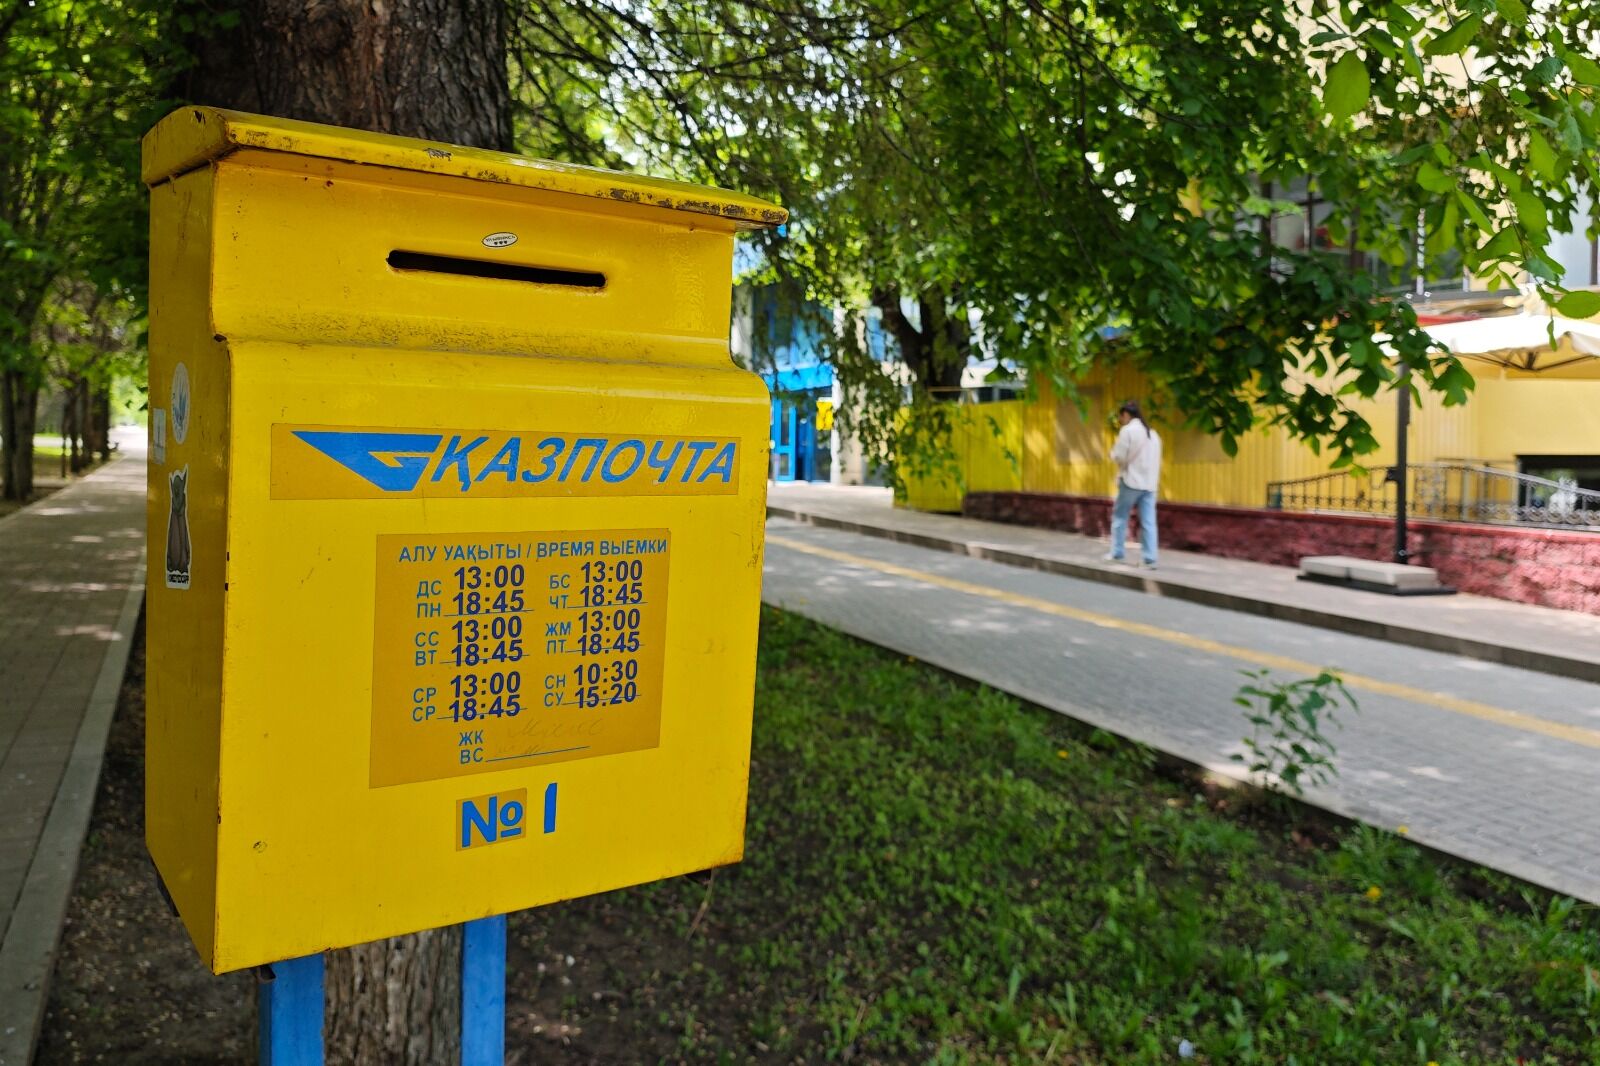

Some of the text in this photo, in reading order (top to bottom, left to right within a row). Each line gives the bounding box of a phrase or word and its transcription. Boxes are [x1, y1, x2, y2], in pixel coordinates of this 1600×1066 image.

[431, 435, 738, 492] ҚАЗПОЧТА
[399, 545, 437, 562] АЛУ
[444, 543, 521, 563] УАҚЫТЫ
[537, 541, 594, 558] ВРЕМЯ
[600, 539, 667, 555] ВЫЕМКИ
[416, 564, 525, 599] ДС 13:00
[549, 560, 643, 589] БС 13:00
[416, 590, 524, 618] ПН 18:45
[549, 582, 643, 609] ЧТ 18:45
[415, 615, 522, 647] СС 13:00
[545, 608, 640, 636] ЖМ 13:00
[415, 639, 523, 667] ВТ 18:45
[547, 632, 640, 656] ПТ 18:45
[413, 671, 521, 704] СР 13:00
[544, 659, 638, 690] СН 10:30
[412, 694, 520, 723] СР 18:45
[544, 681, 637, 708] СУ 15:20
[459, 729, 484, 746] ЖК
[460, 747, 484, 764] ВС
